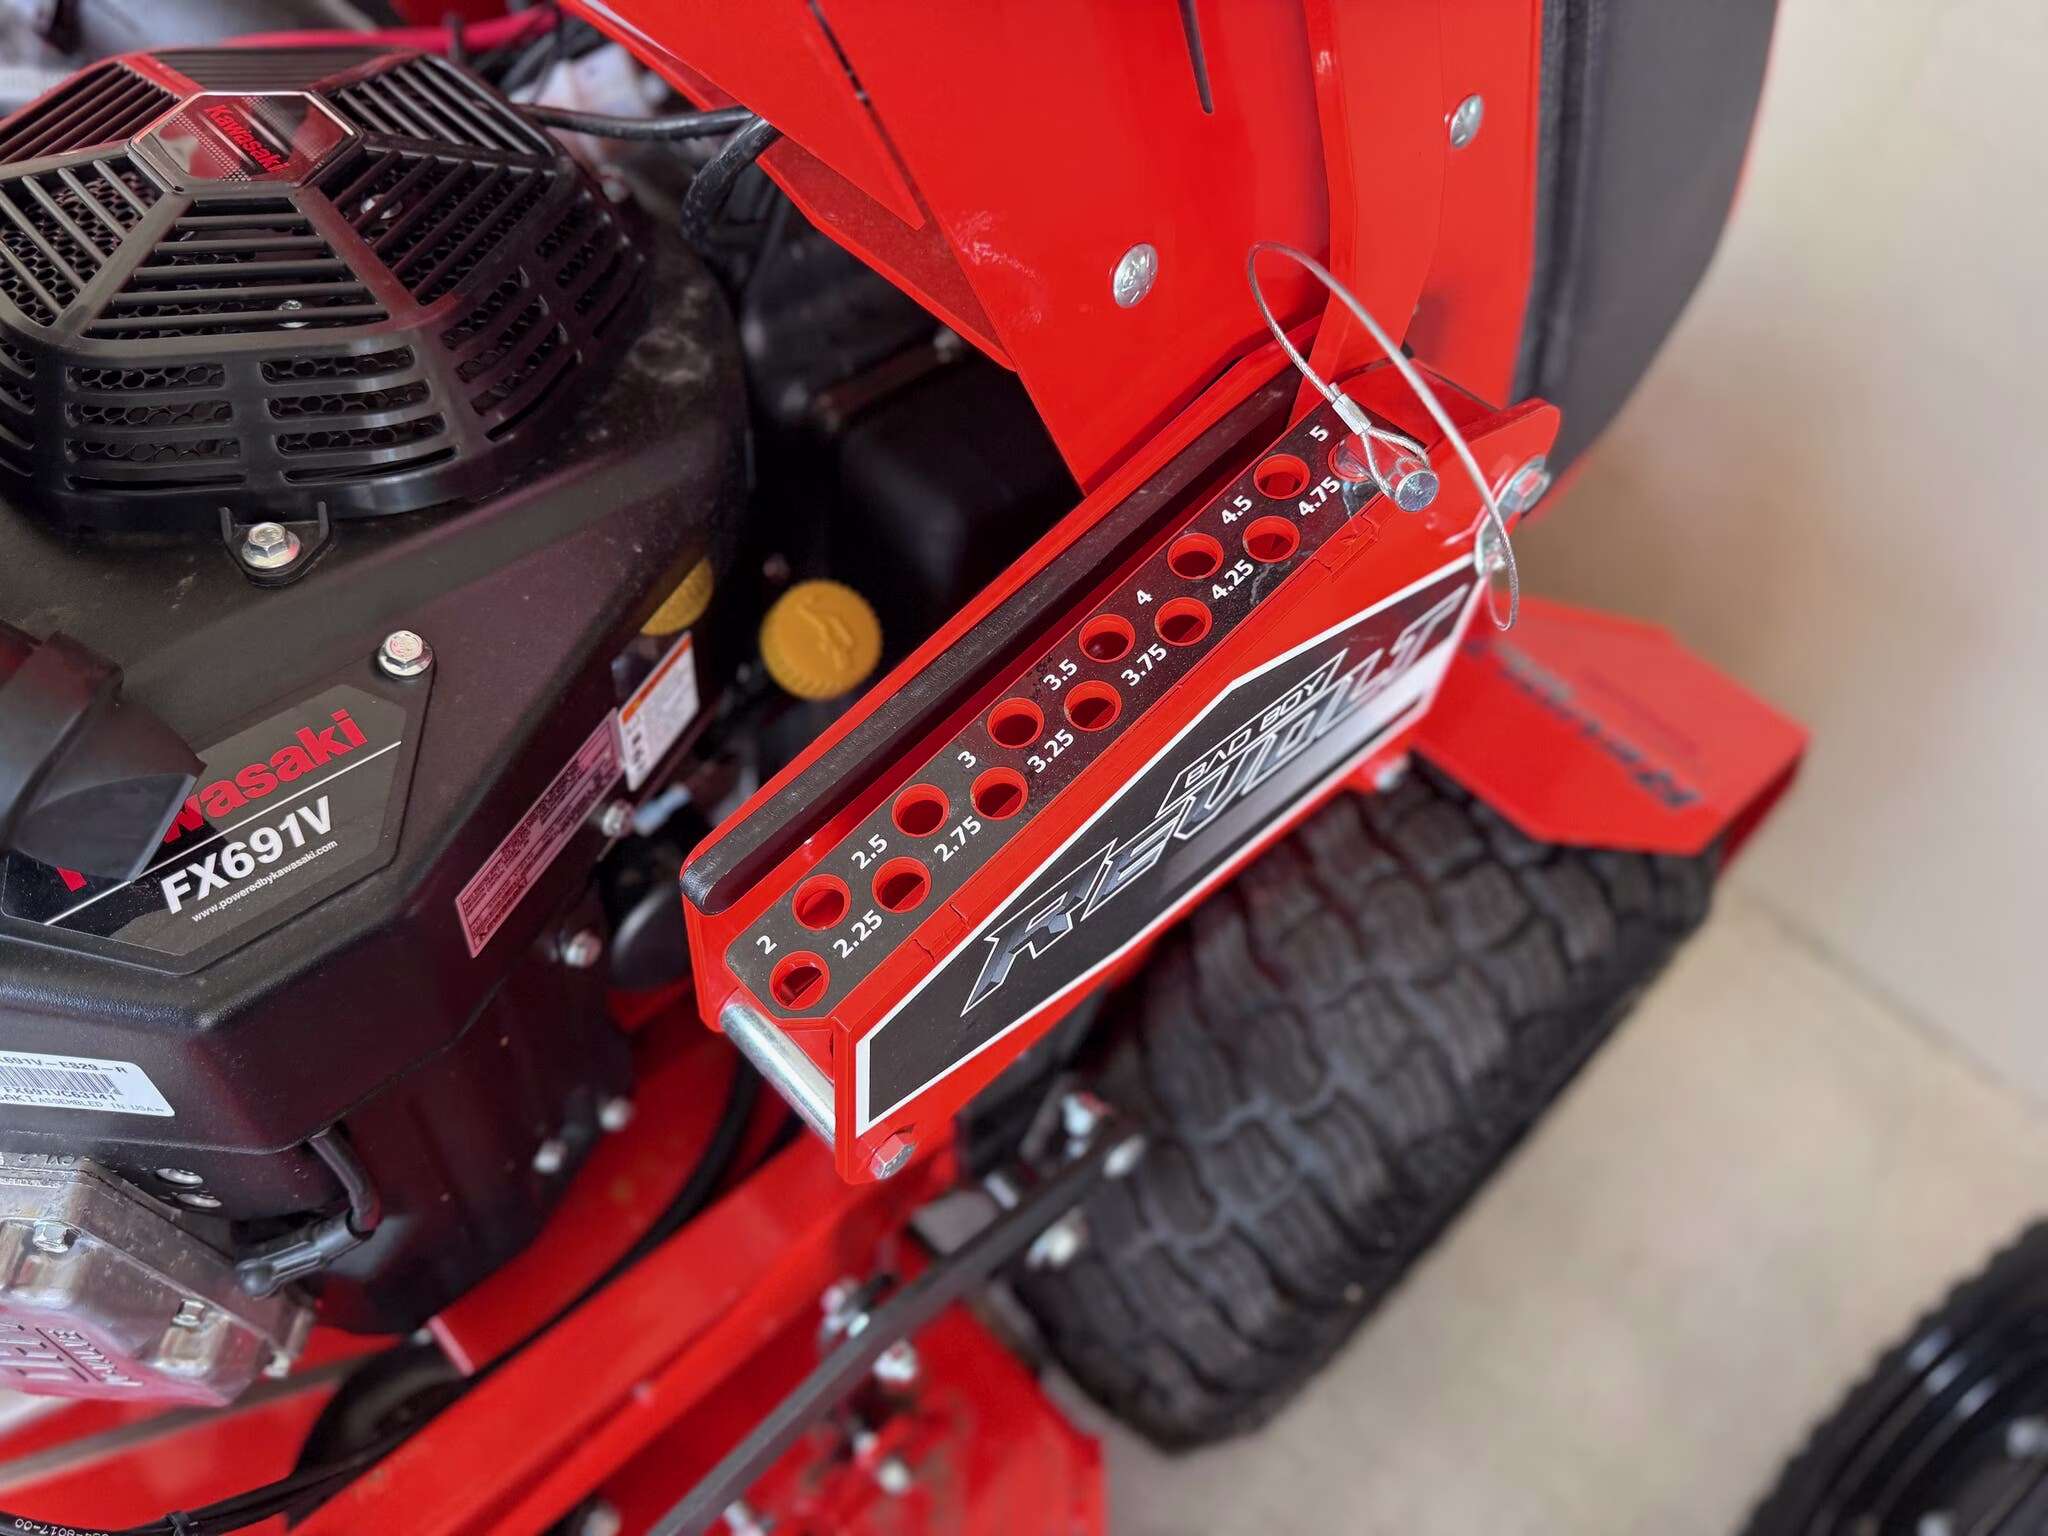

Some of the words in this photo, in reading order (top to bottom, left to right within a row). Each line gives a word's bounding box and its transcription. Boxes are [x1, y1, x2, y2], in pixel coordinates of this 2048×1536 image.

[203, 104, 290, 172] Kawasaki
[756, 935, 778, 955] 2
[851, 833, 888, 870] 2.5
[957, 750, 977, 769] 3
[1042, 658, 1078, 691] 3.5
[1135, 588, 1153, 605] 4
[1221, 495, 1253, 525] 4.5
[1309, 425, 1329, 442] 5
[833, 909, 883, 959] 2.25
[933, 815, 982, 863] 2.75
[1026, 728, 1075, 774] 3.25
[1120, 643, 1168, 687] 3.75
[1211, 559, 1255, 600] 4.25
[1298, 475, 1341, 517] 4.75
[1185, 728, 1252, 789] BAD
[1260, 671, 1327, 732] BOY
[160, 795, 332, 915] FX691V
[191, 839, 338, 923] www.poweredbykawasaki.com
